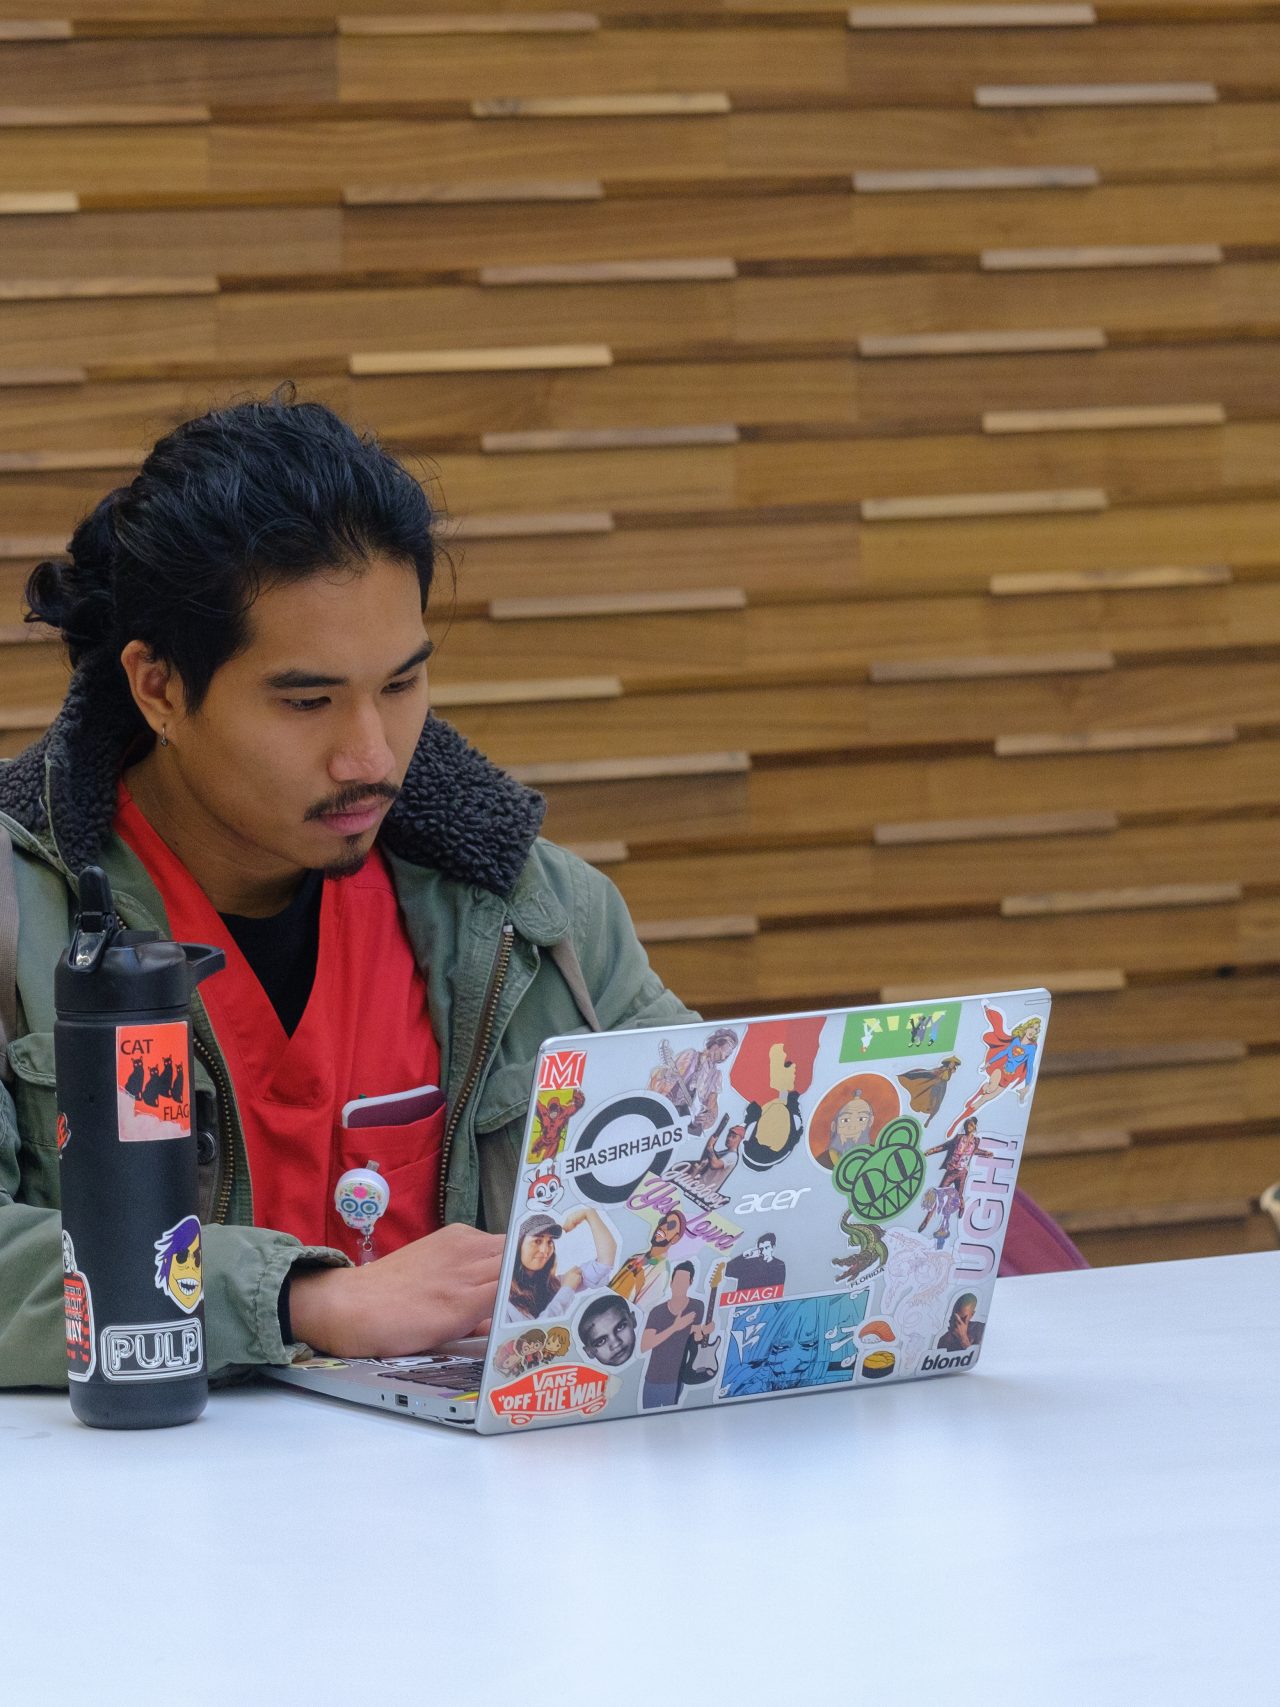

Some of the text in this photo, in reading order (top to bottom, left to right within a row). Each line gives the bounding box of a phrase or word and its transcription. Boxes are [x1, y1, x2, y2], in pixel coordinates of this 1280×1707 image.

[120, 1039, 153, 1055] CAT
[538, 1051, 587, 1090] M
[164, 1104, 189, 1121] FLAG
[626, 1177, 681, 1215] Yes
[734, 1187, 812, 1215] acer
[952, 1137, 1018, 1280] UGH!
[850, 1267, 885, 1289] FLORIDA
[726, 1286, 779, 1304] UNAGI
[107, 1327, 198, 1374] PULP
[921, 1351, 975, 1371] blond
[532, 1367, 578, 1392] VANS
[535, 1387, 568, 1411] THE
[569, 1380, 605, 1407] WAL
